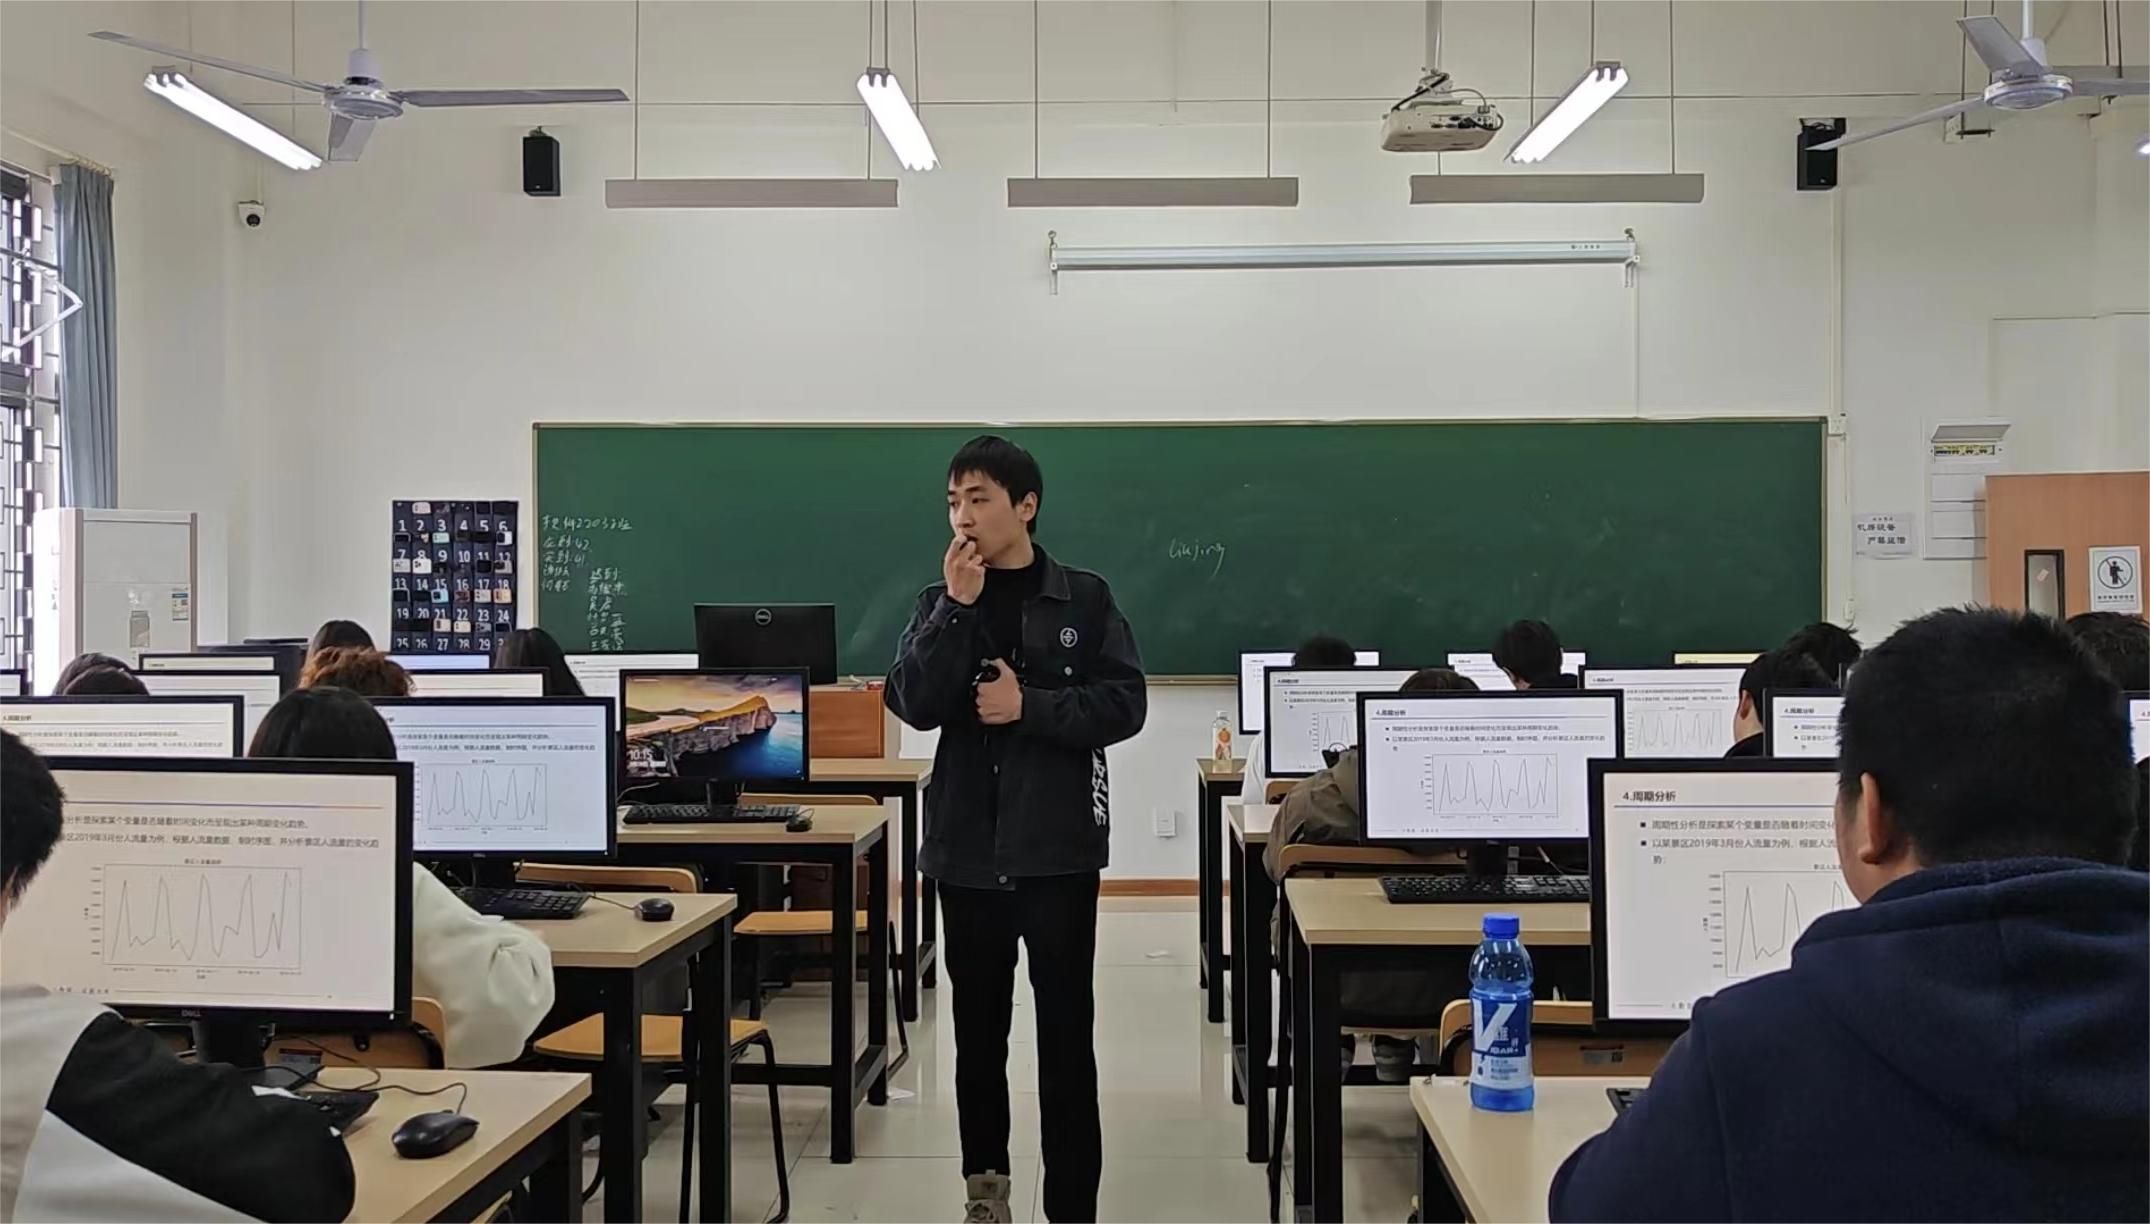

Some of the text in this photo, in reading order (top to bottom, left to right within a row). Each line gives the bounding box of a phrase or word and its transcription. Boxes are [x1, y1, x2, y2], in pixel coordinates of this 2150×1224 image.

[398, 519, 507, 531] 1 2 3 4 5 6
[397, 549, 406, 559] 7
[417, 550, 426, 559] 8
[438, 550, 447, 562] 9
[458, 551, 471, 563] 10
[478, 551, 490, 561] 11
[395, 578, 509, 591] 13 14 15 16 17 18
[397, 608, 510, 621] 19 20 21 22 23 24
[437, 638, 449, 650] 27
[479, 639, 491, 650] 29
[1622, 790, 1677, 803] 4.周期分析
